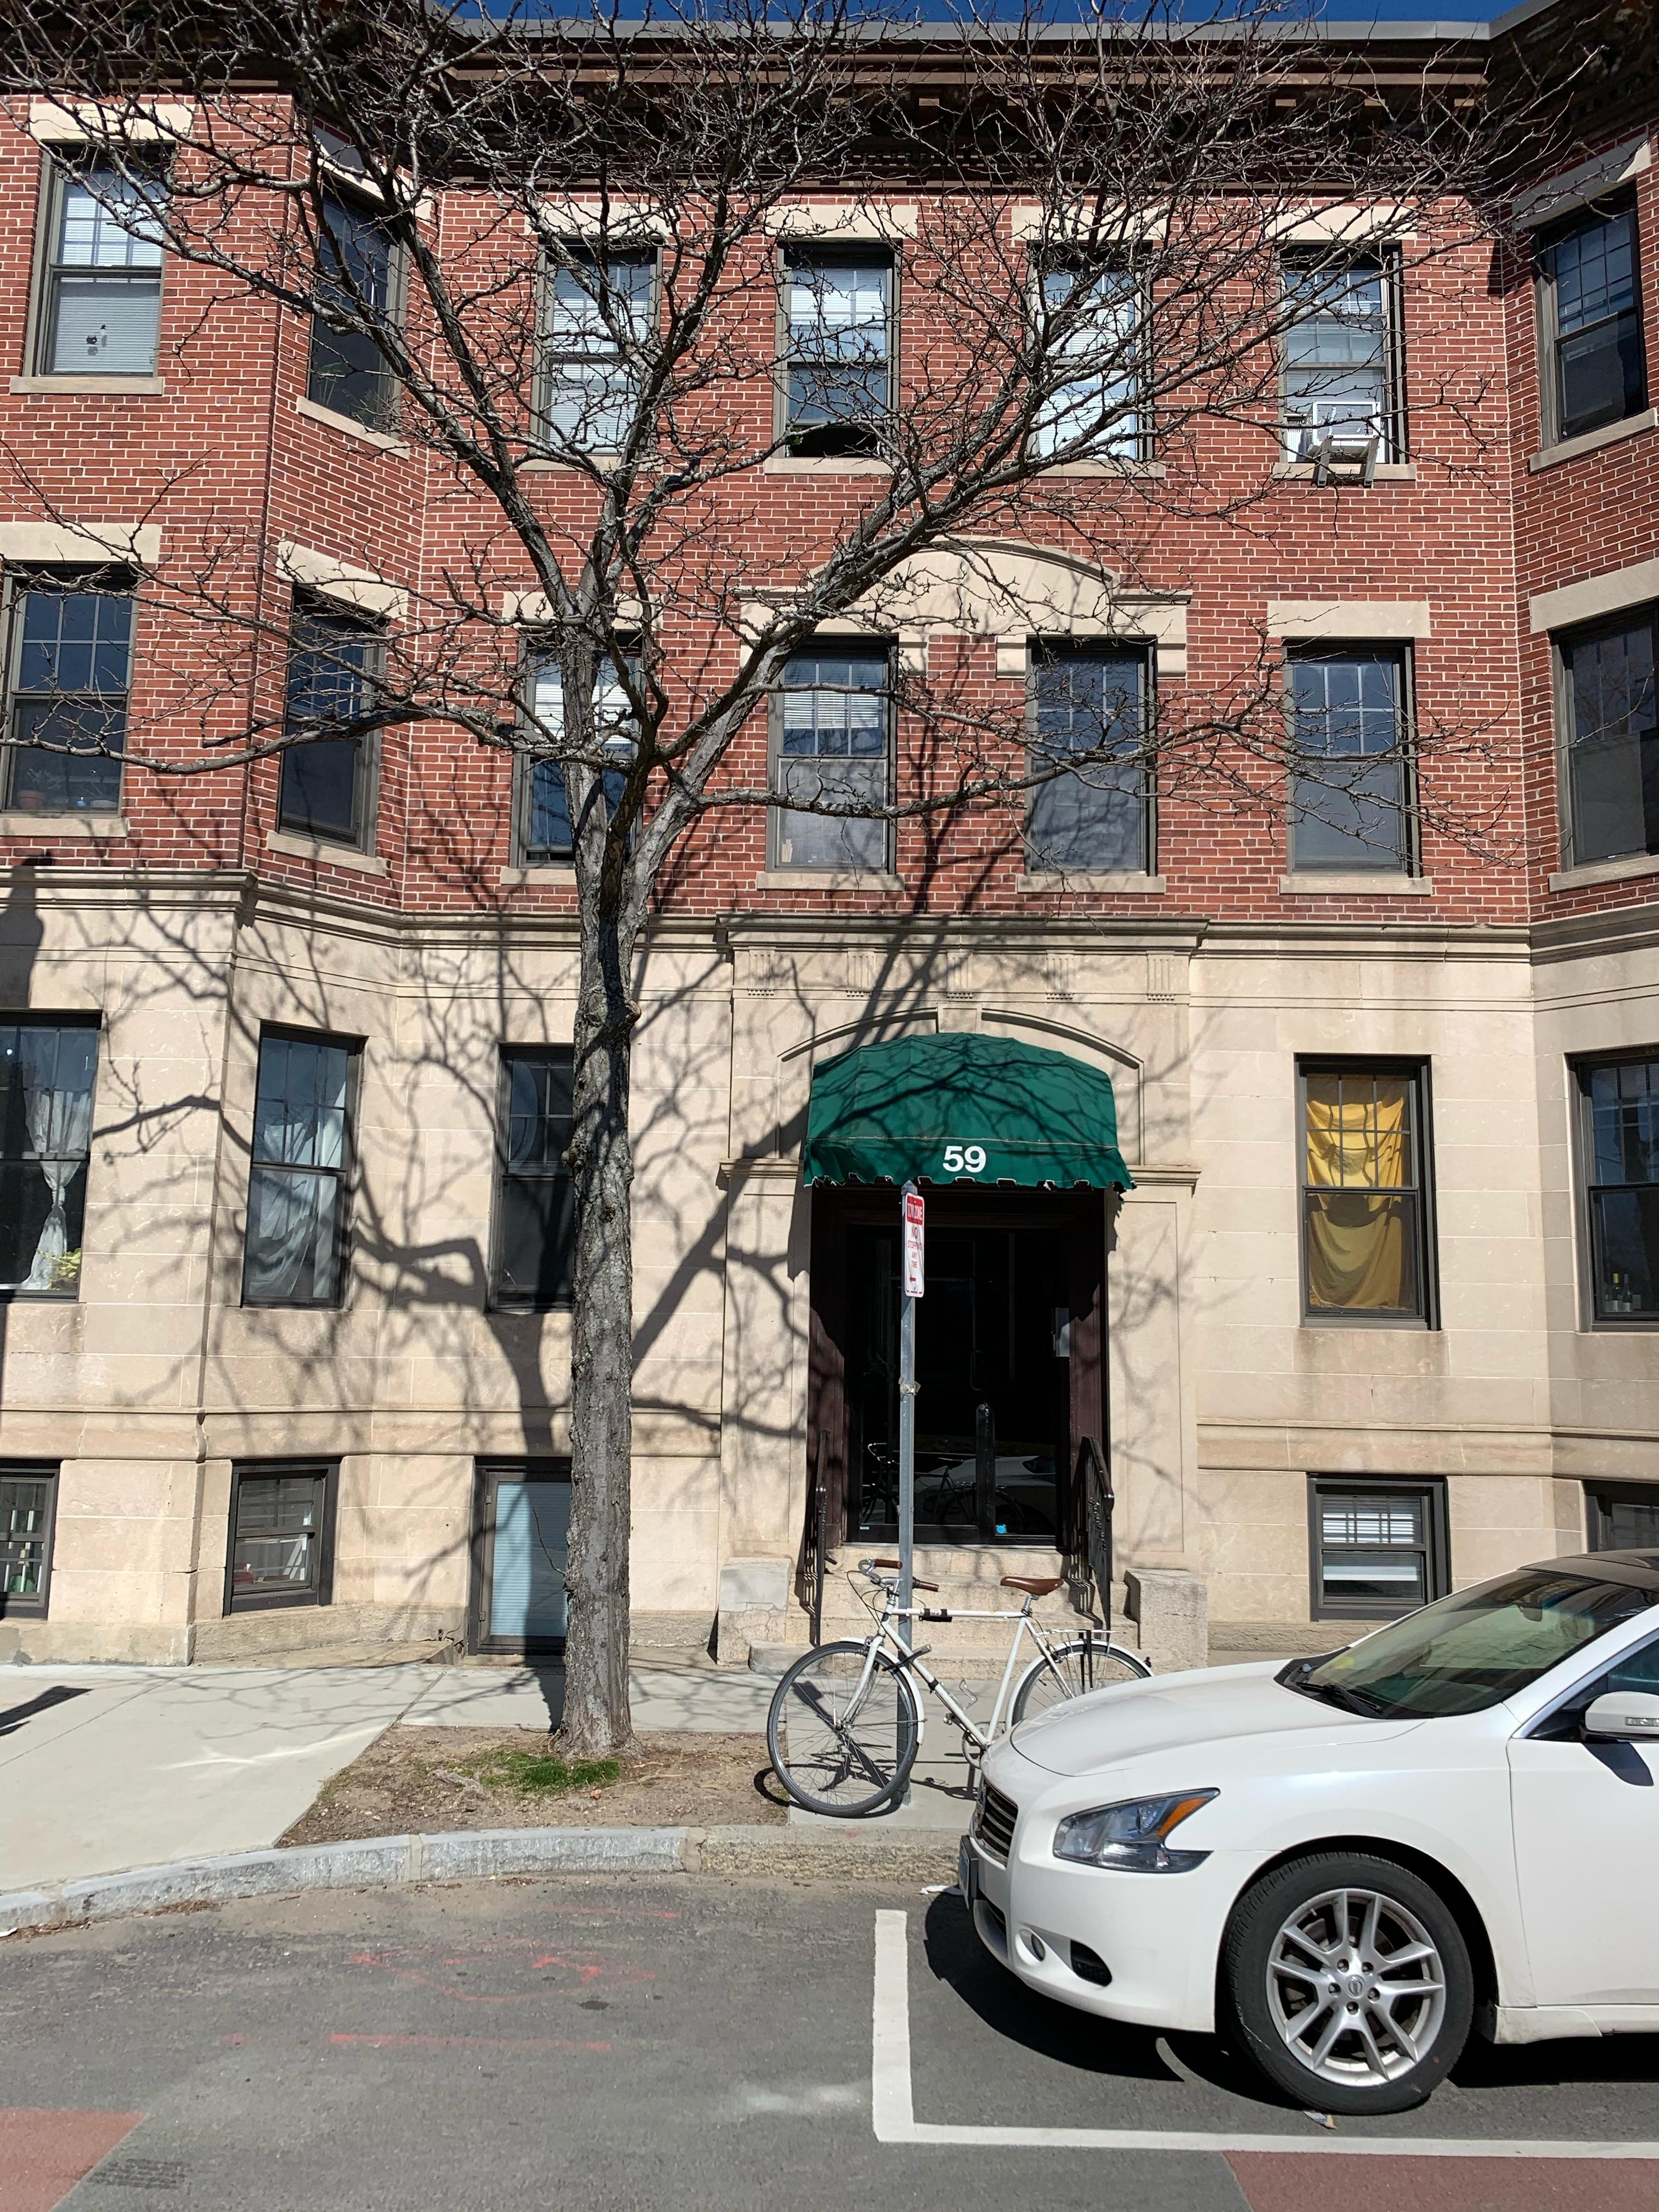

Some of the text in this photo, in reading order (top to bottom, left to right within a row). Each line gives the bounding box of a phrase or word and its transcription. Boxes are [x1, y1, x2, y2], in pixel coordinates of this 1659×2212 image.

[943, 1146, 986, 1173] 59
[911, 1226, 918, 1238] NO
[907, 1240, 922, 1250] STOPPING
